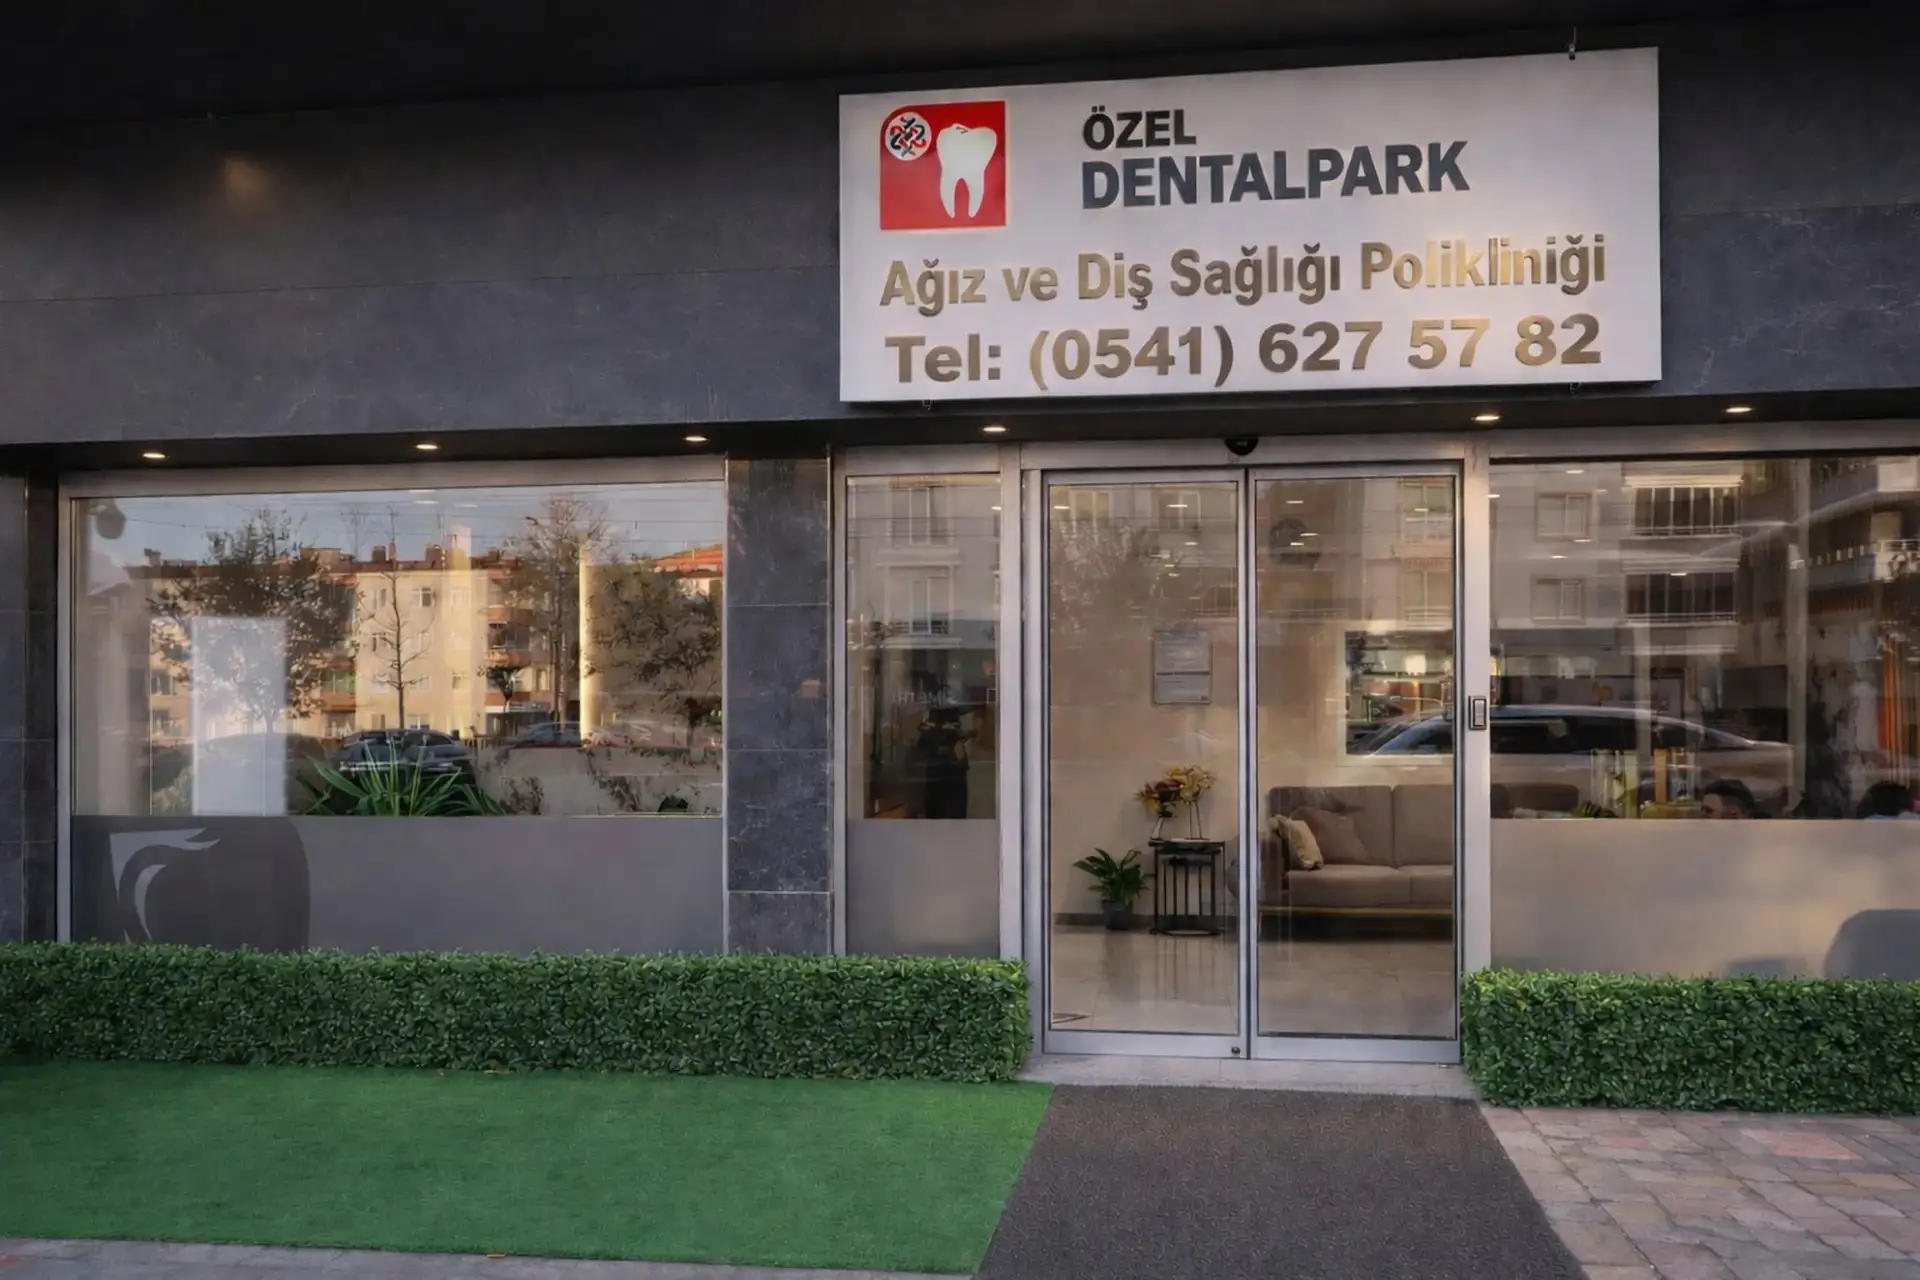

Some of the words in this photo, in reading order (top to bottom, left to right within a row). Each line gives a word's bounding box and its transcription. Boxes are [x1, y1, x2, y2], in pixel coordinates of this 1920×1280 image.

[1082, 105, 1197, 151] ÖZEL
[1081, 140, 1470, 210] DENTALPARK
[880, 257, 987, 318] Ağız
[1002, 267, 1059, 303] ve
[1077, 251, 1154, 311] Diş
[1169, 242, 1341, 306] Sağlığı
[1360, 233, 1607, 297] Polikliniği
[884, 334, 1002, 384] Tel:
[1028, 323, 1235, 390] (0541)
[1258, 320, 1383, 373] 627
[1407, 317, 1490, 370] 57
[1514, 313, 1601, 367] 82
